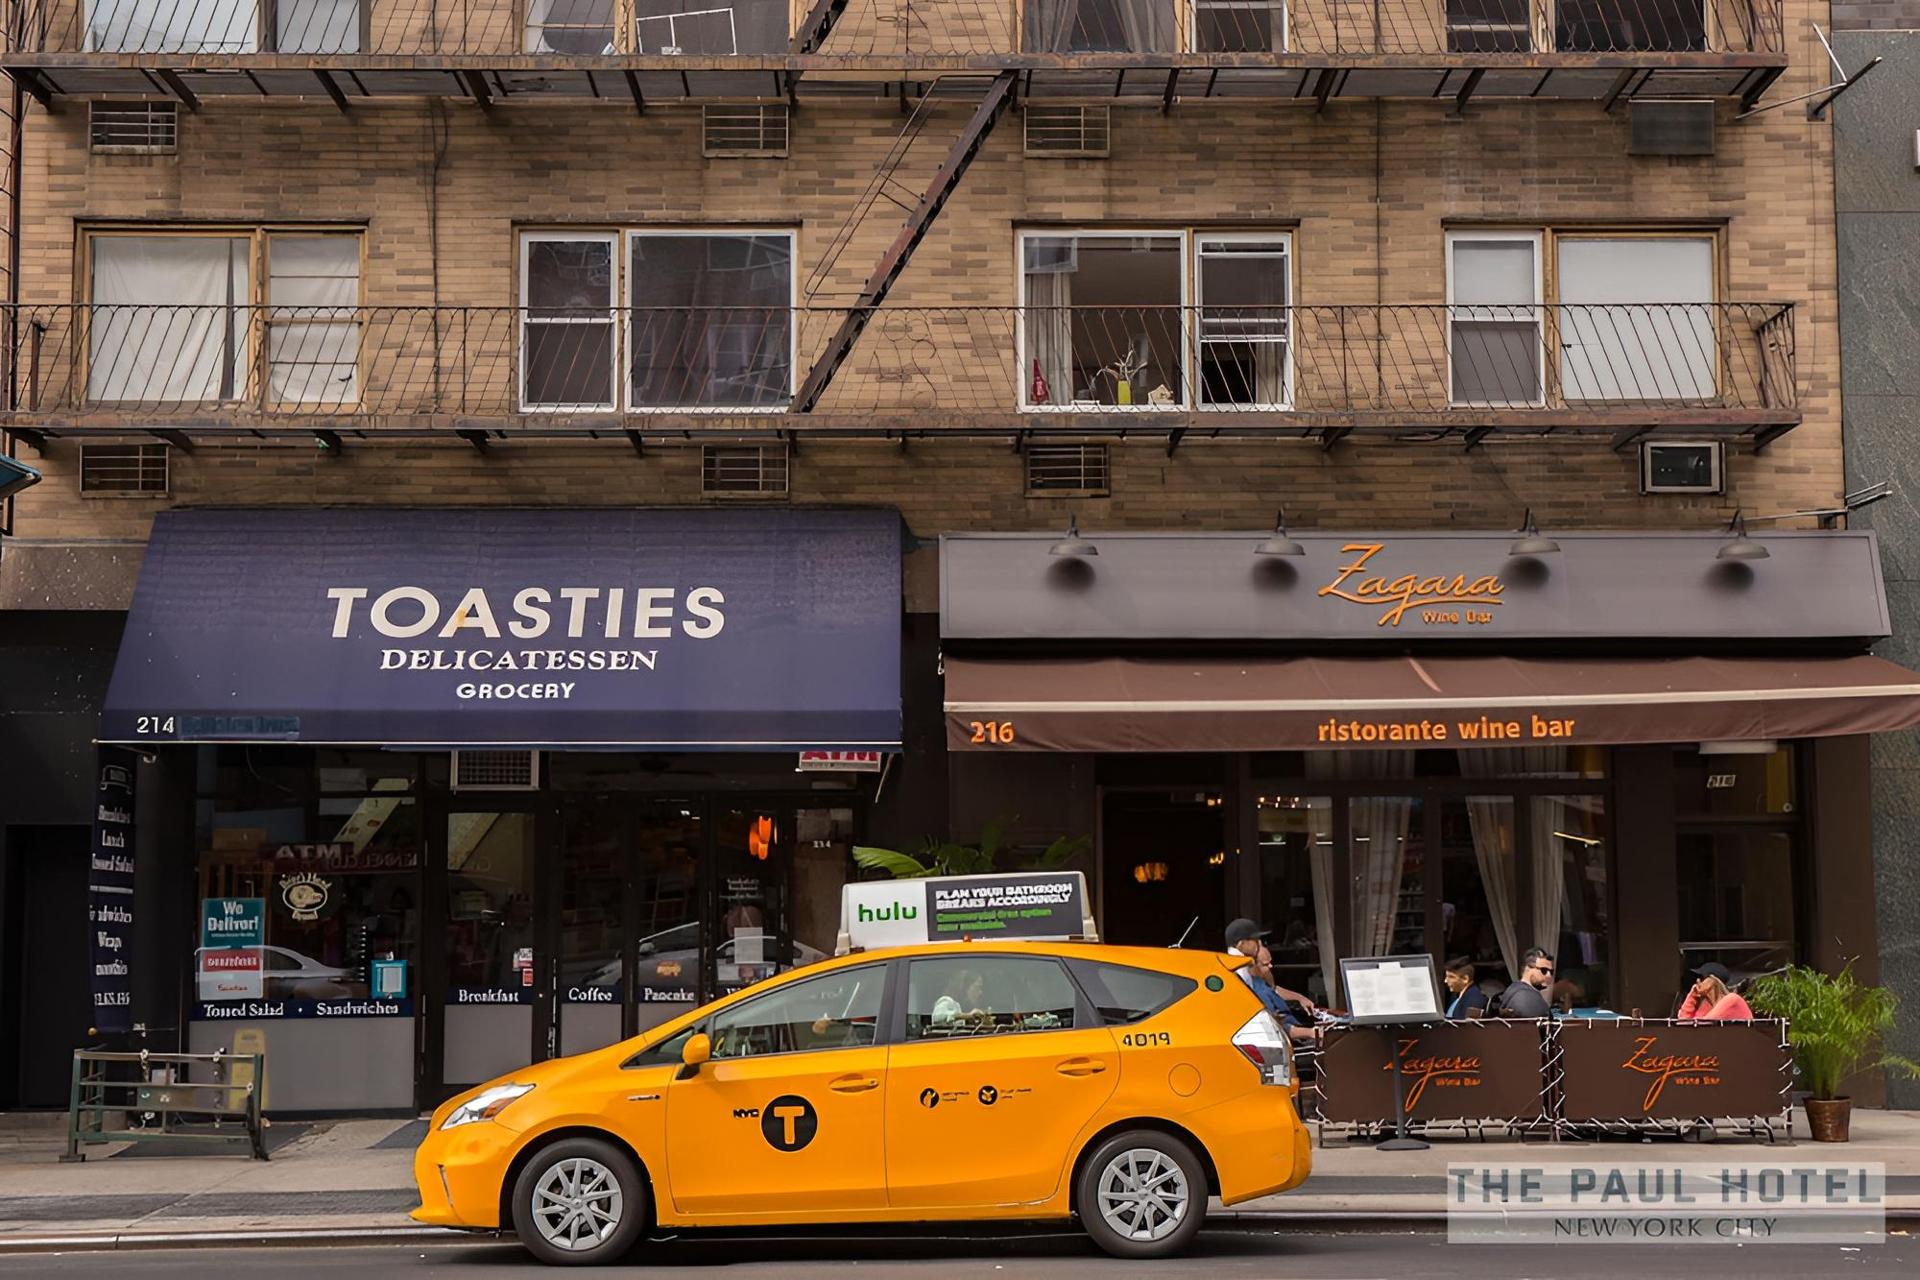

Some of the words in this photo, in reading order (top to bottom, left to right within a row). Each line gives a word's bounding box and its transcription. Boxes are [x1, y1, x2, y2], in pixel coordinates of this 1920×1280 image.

[1318, 543, 1505, 626] Zagara
[327, 587, 726, 639] TOASTIES
[380, 649, 658, 671] DELICATESSEN
[456, 682, 575, 699] GROCERY
[136, 716, 175, 734] 214
[970, 721, 1014, 743] 216
[1318, 718, 1447, 741] ristorante
[1457, 716, 1520, 739] wine
[1531, 715, 1575, 738] bar
[275, 844, 342, 859] ATM
[935, 889, 970, 899] PLAN
[971, 887, 1004, 898] YOUR
[223, 901, 243, 915] We
[858, 902, 917, 922] hulu
[458, 989, 519, 1002] Breakfast
[568, 987, 612, 1001] Coffee
[1123, 1032, 1170, 1046] 4019
[1383, 1039, 1480, 1112] Zagara
[1623, 1036, 1720, 1112] Zagara
[733, 1109, 759, 1118] NYC
[773, 1105, 805, 1145] T
